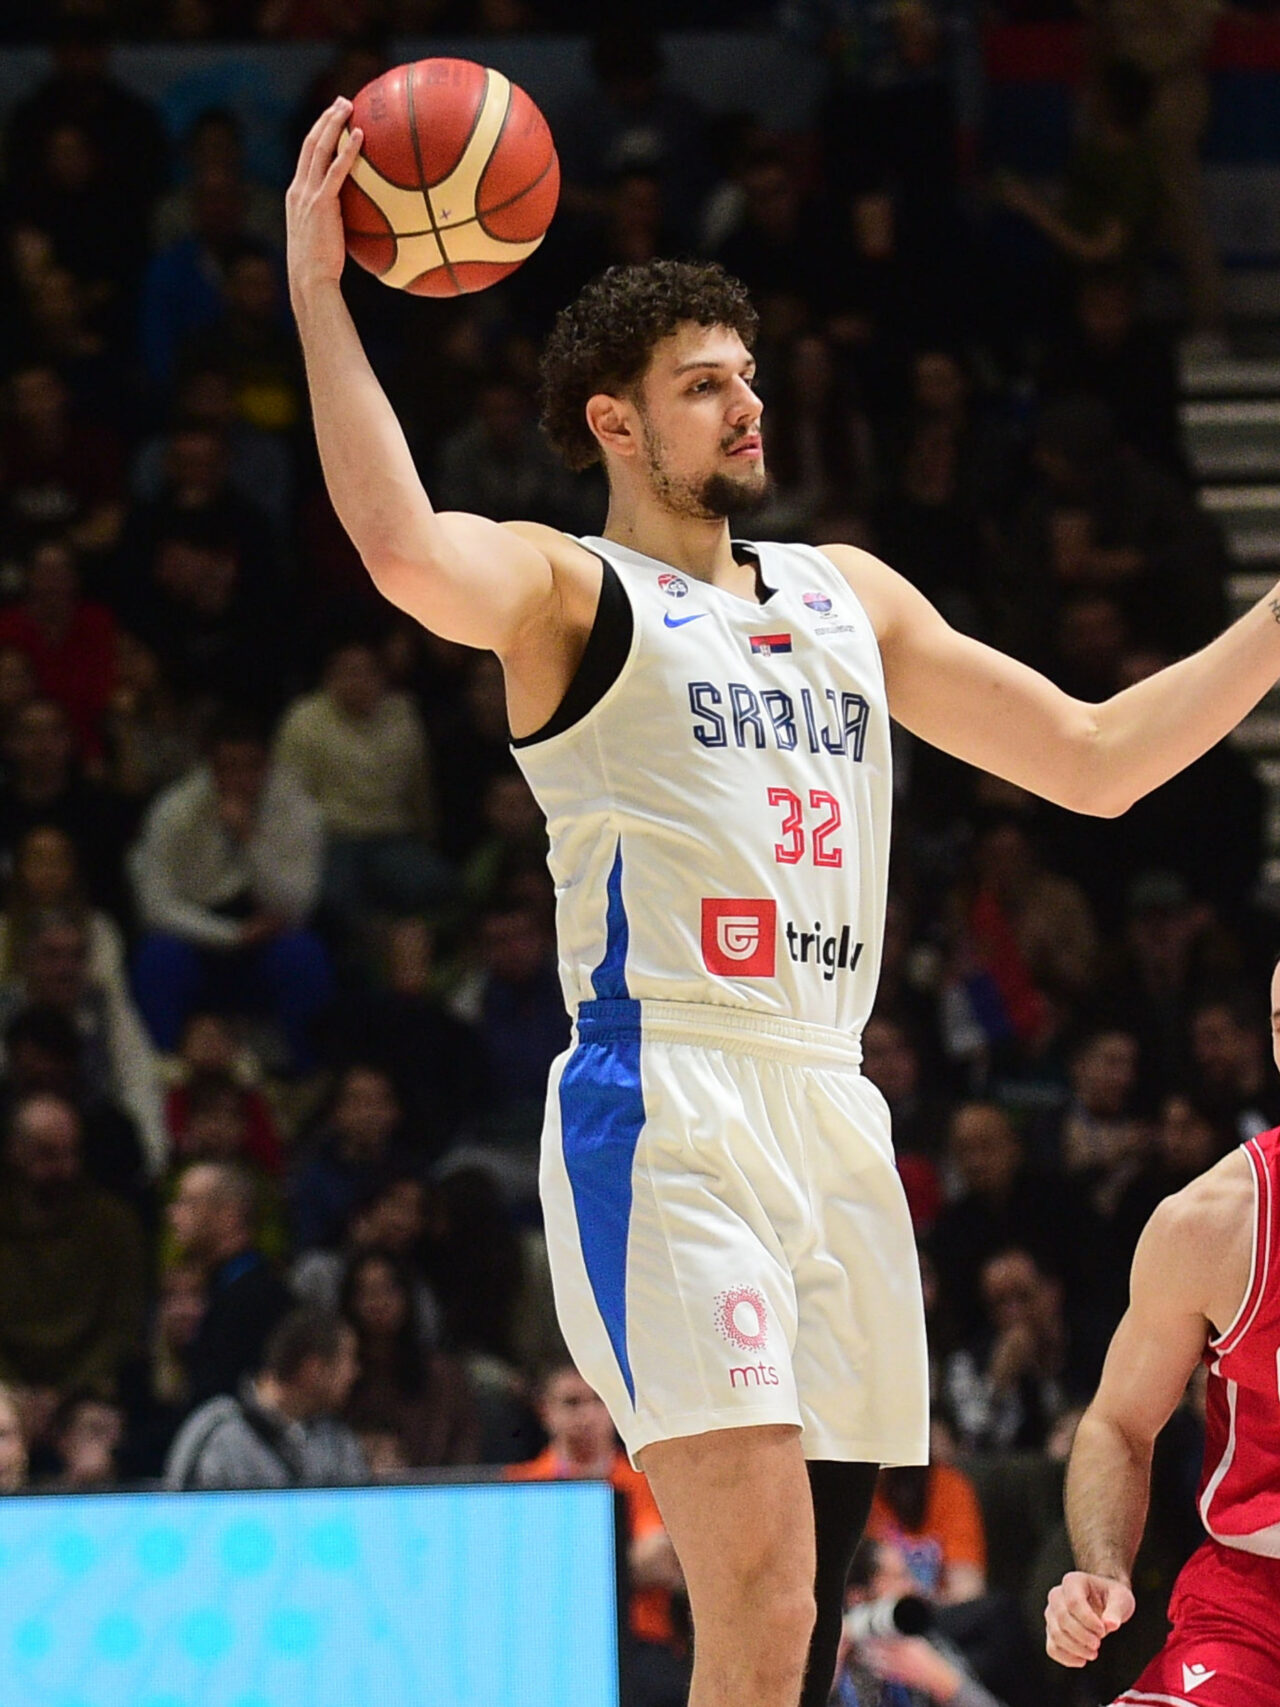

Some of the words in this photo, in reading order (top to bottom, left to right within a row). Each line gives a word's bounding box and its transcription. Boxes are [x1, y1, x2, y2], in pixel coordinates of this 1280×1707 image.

[688, 681, 870, 763] SRBIJA
[767, 787, 843, 868] 32
[729, 1361, 780, 1388] mts
